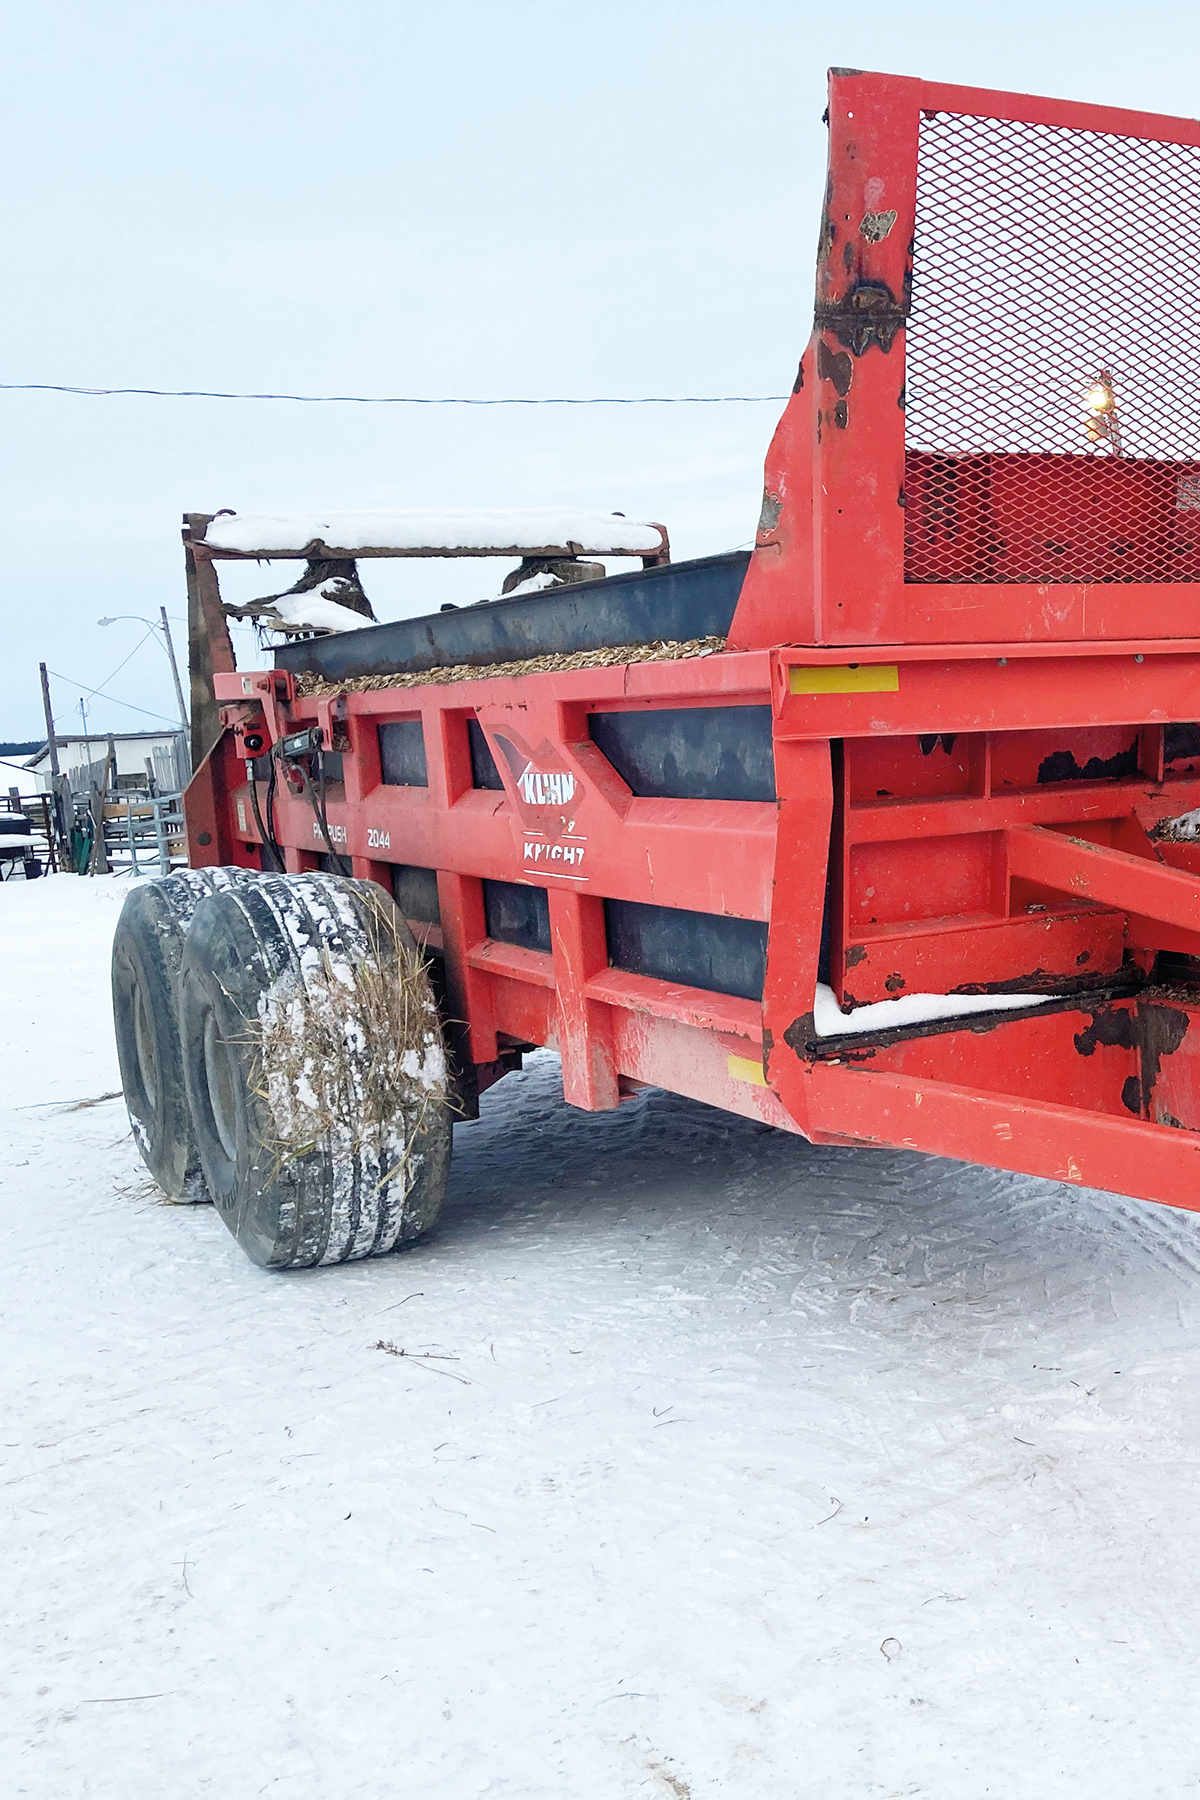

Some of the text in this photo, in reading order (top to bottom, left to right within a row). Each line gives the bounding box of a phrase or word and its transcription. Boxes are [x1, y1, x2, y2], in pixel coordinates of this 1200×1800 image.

[523, 771, 575, 806] KUHN
[367, 828, 391, 850] 2044
[523, 842, 585, 866] KNIGHT
